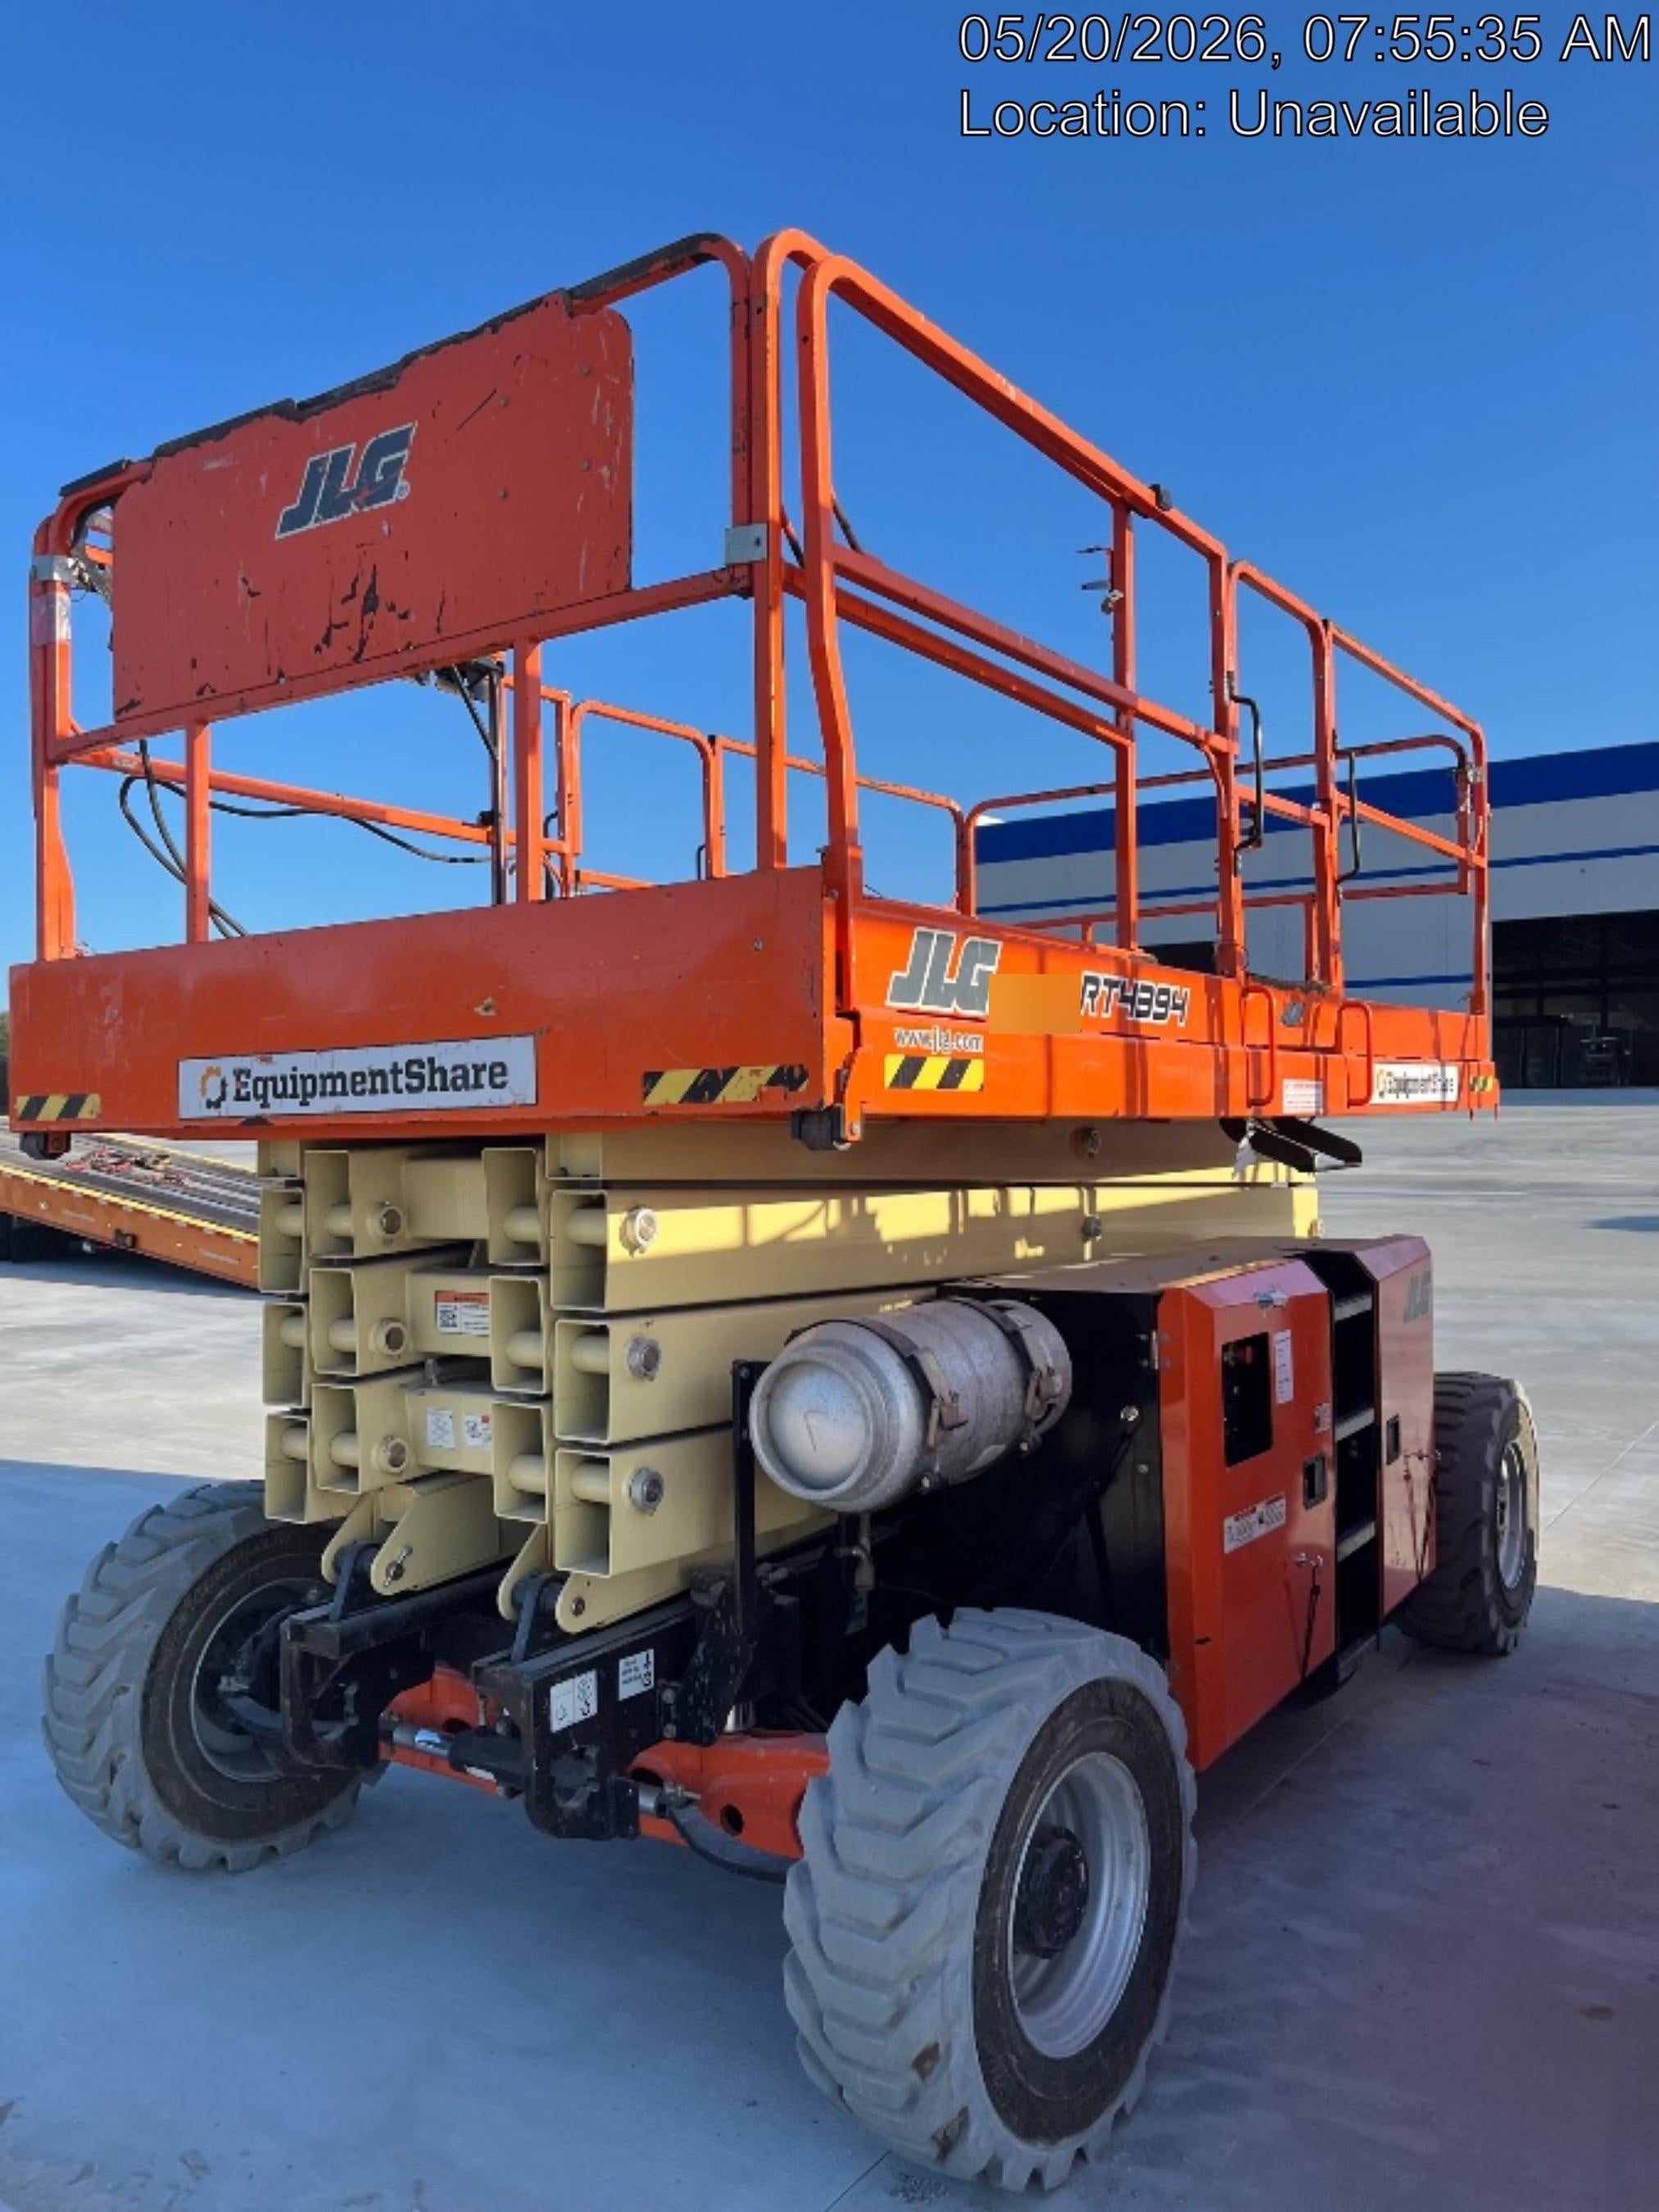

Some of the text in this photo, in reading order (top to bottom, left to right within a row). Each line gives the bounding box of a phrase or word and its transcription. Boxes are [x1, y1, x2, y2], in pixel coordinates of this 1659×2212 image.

[274, 420, 418, 541] JLG
[885, 927, 1003, 1016] JLG
[894, 1025, 984, 1055] www.jlg.com
[233, 1056, 509, 1108] EquipmentShare
